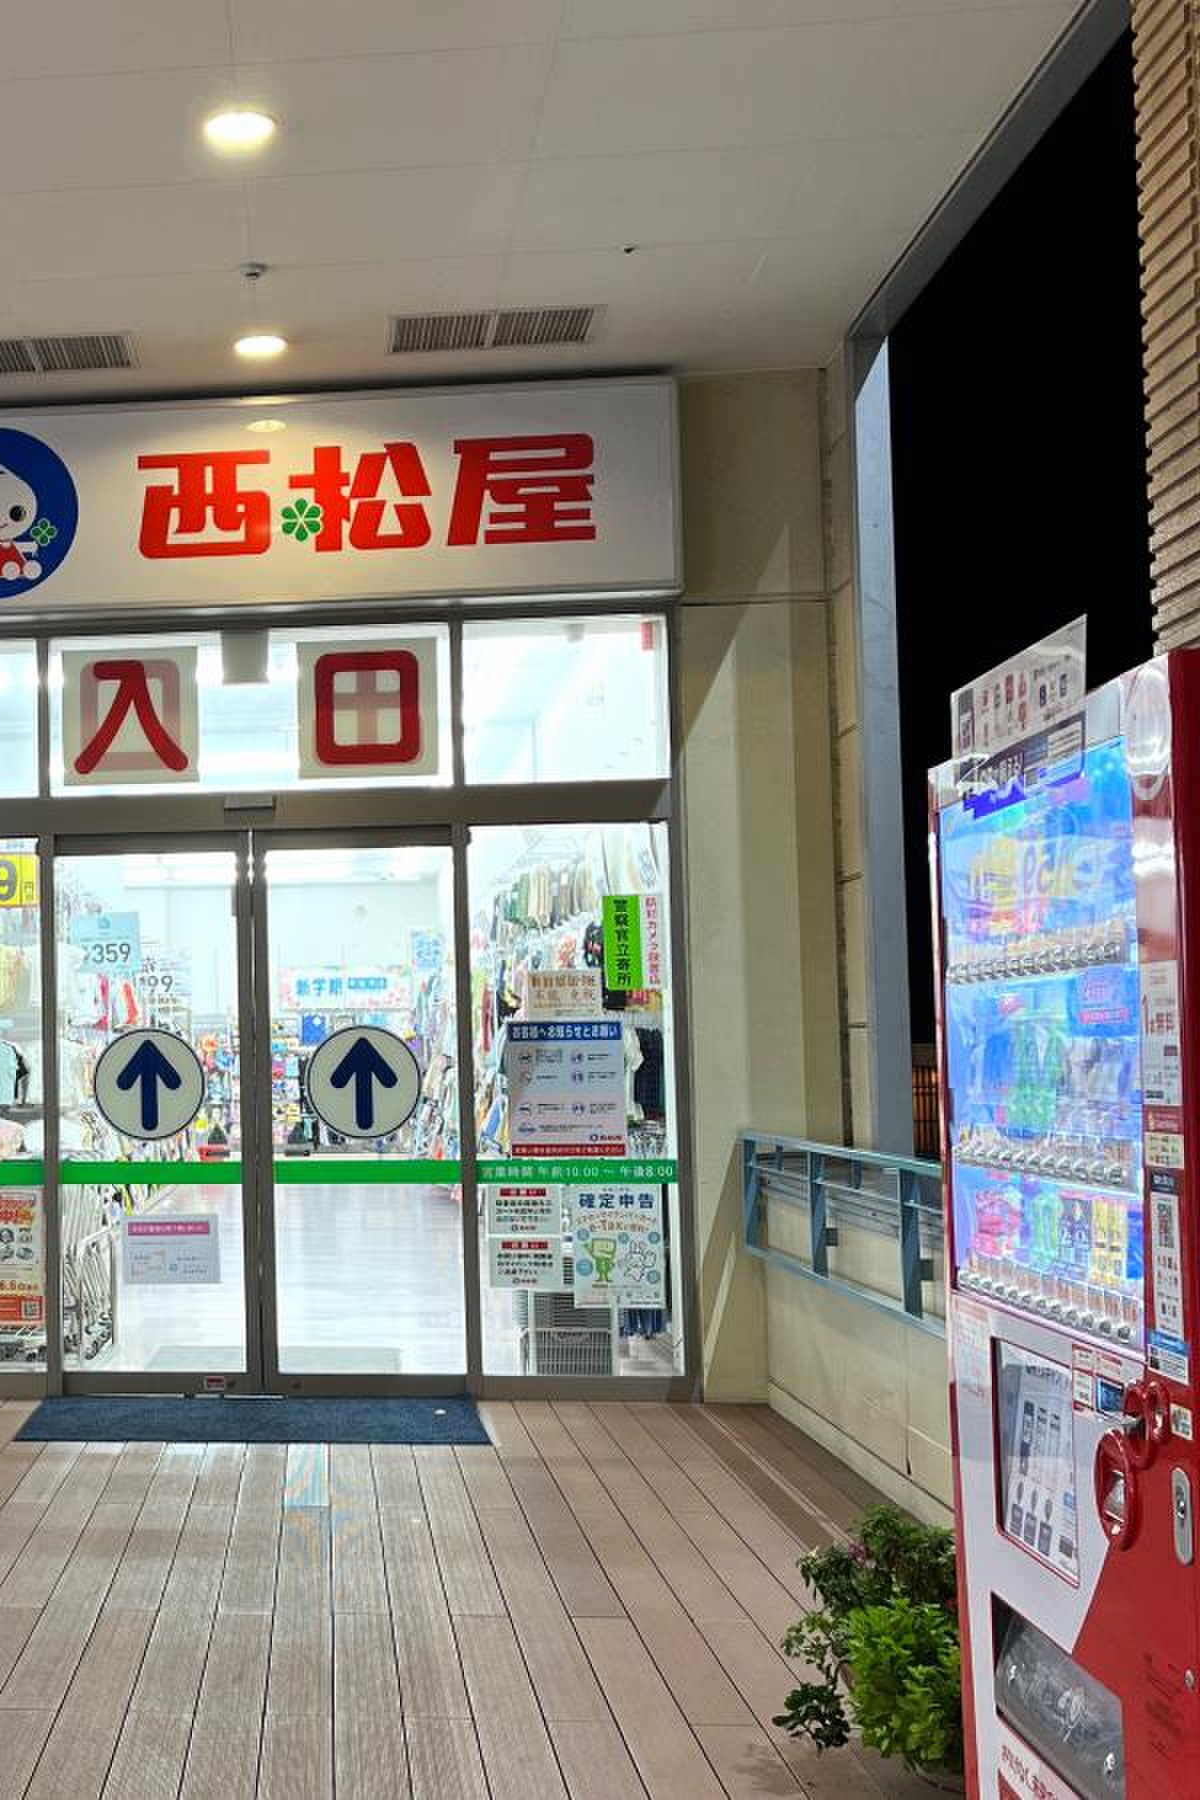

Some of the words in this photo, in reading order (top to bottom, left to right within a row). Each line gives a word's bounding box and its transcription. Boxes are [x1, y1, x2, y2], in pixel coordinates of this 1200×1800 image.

[137, 432, 597, 560] 西松屋
[74, 649, 422, 773] 入口
[578, 1192, 655, 1209] 確定申告
